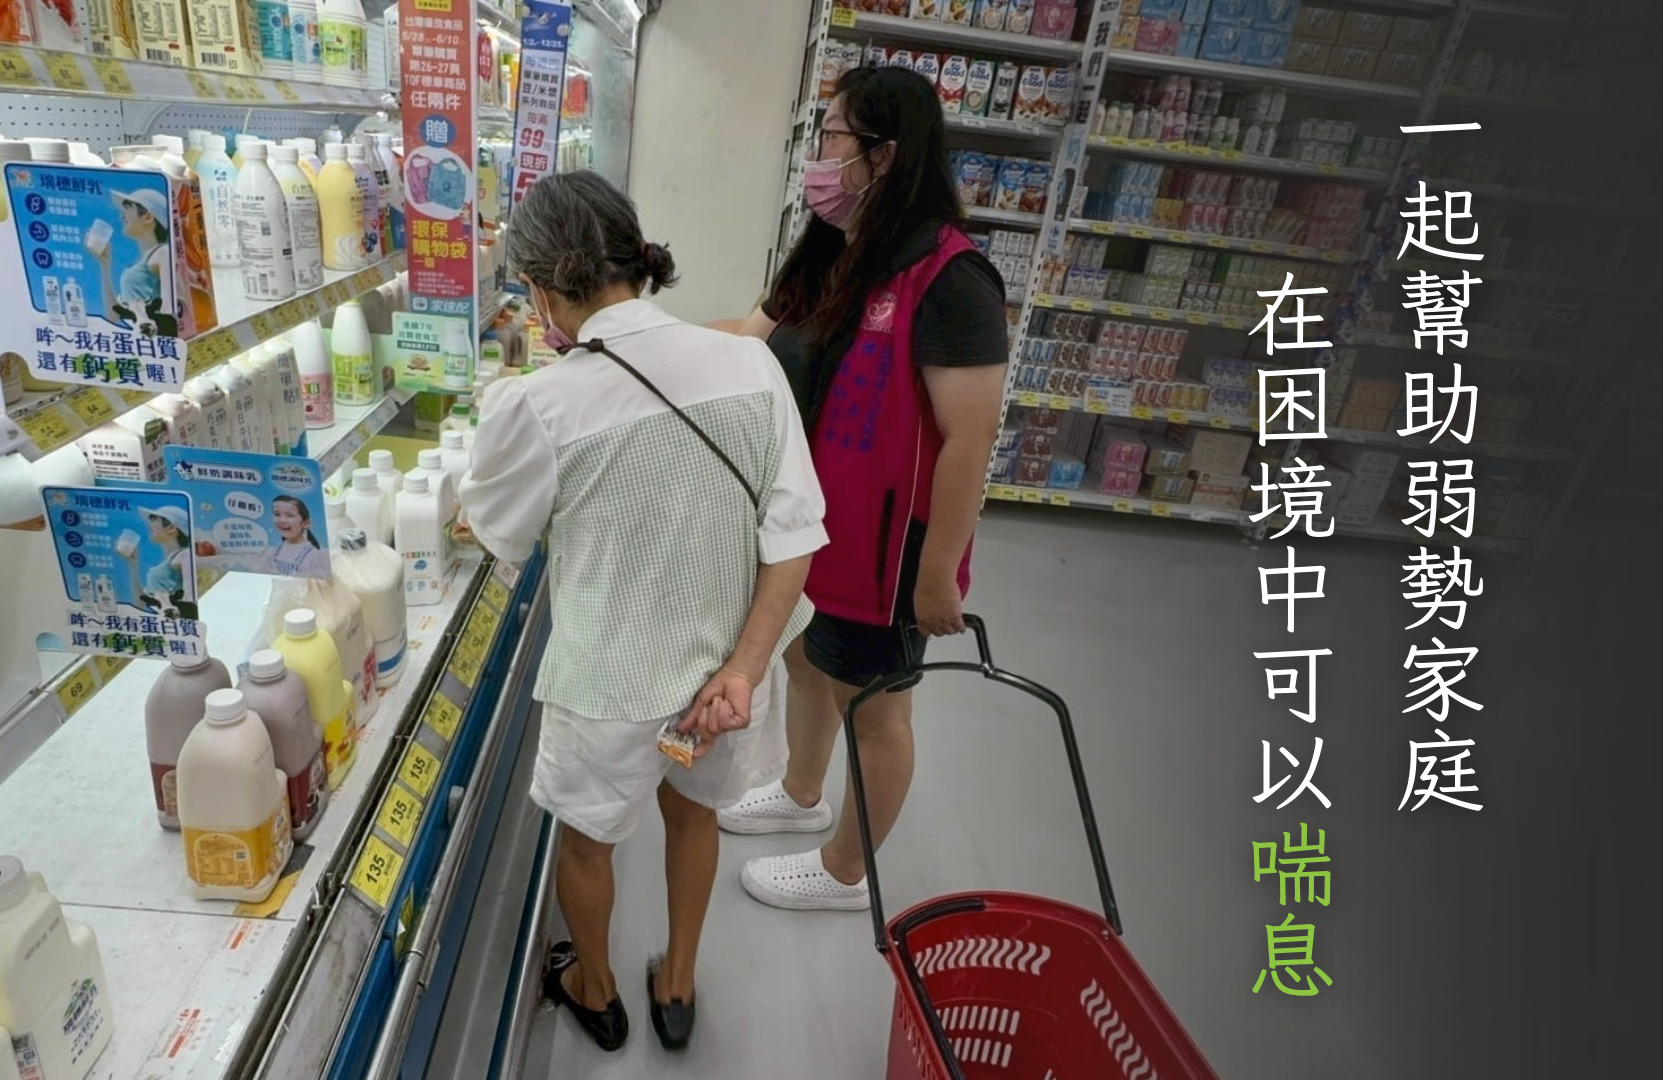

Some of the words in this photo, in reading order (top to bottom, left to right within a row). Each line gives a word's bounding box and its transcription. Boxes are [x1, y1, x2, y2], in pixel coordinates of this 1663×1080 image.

[410, 90, 462, 111] 任兩件
[425, 119, 449, 144] 贈
[39, 173, 103, 196] 瑞穗鮮乳
[412, 220, 449, 239] 環保
[412, 238, 467, 259] 購物袋
[197, 466, 258, 482] 鮮奶調味乳
[70, 681, 84, 698] 69
[410, 756, 426, 781] 135
[390, 800, 408, 826] 135
[366, 854, 386, 885] 135
